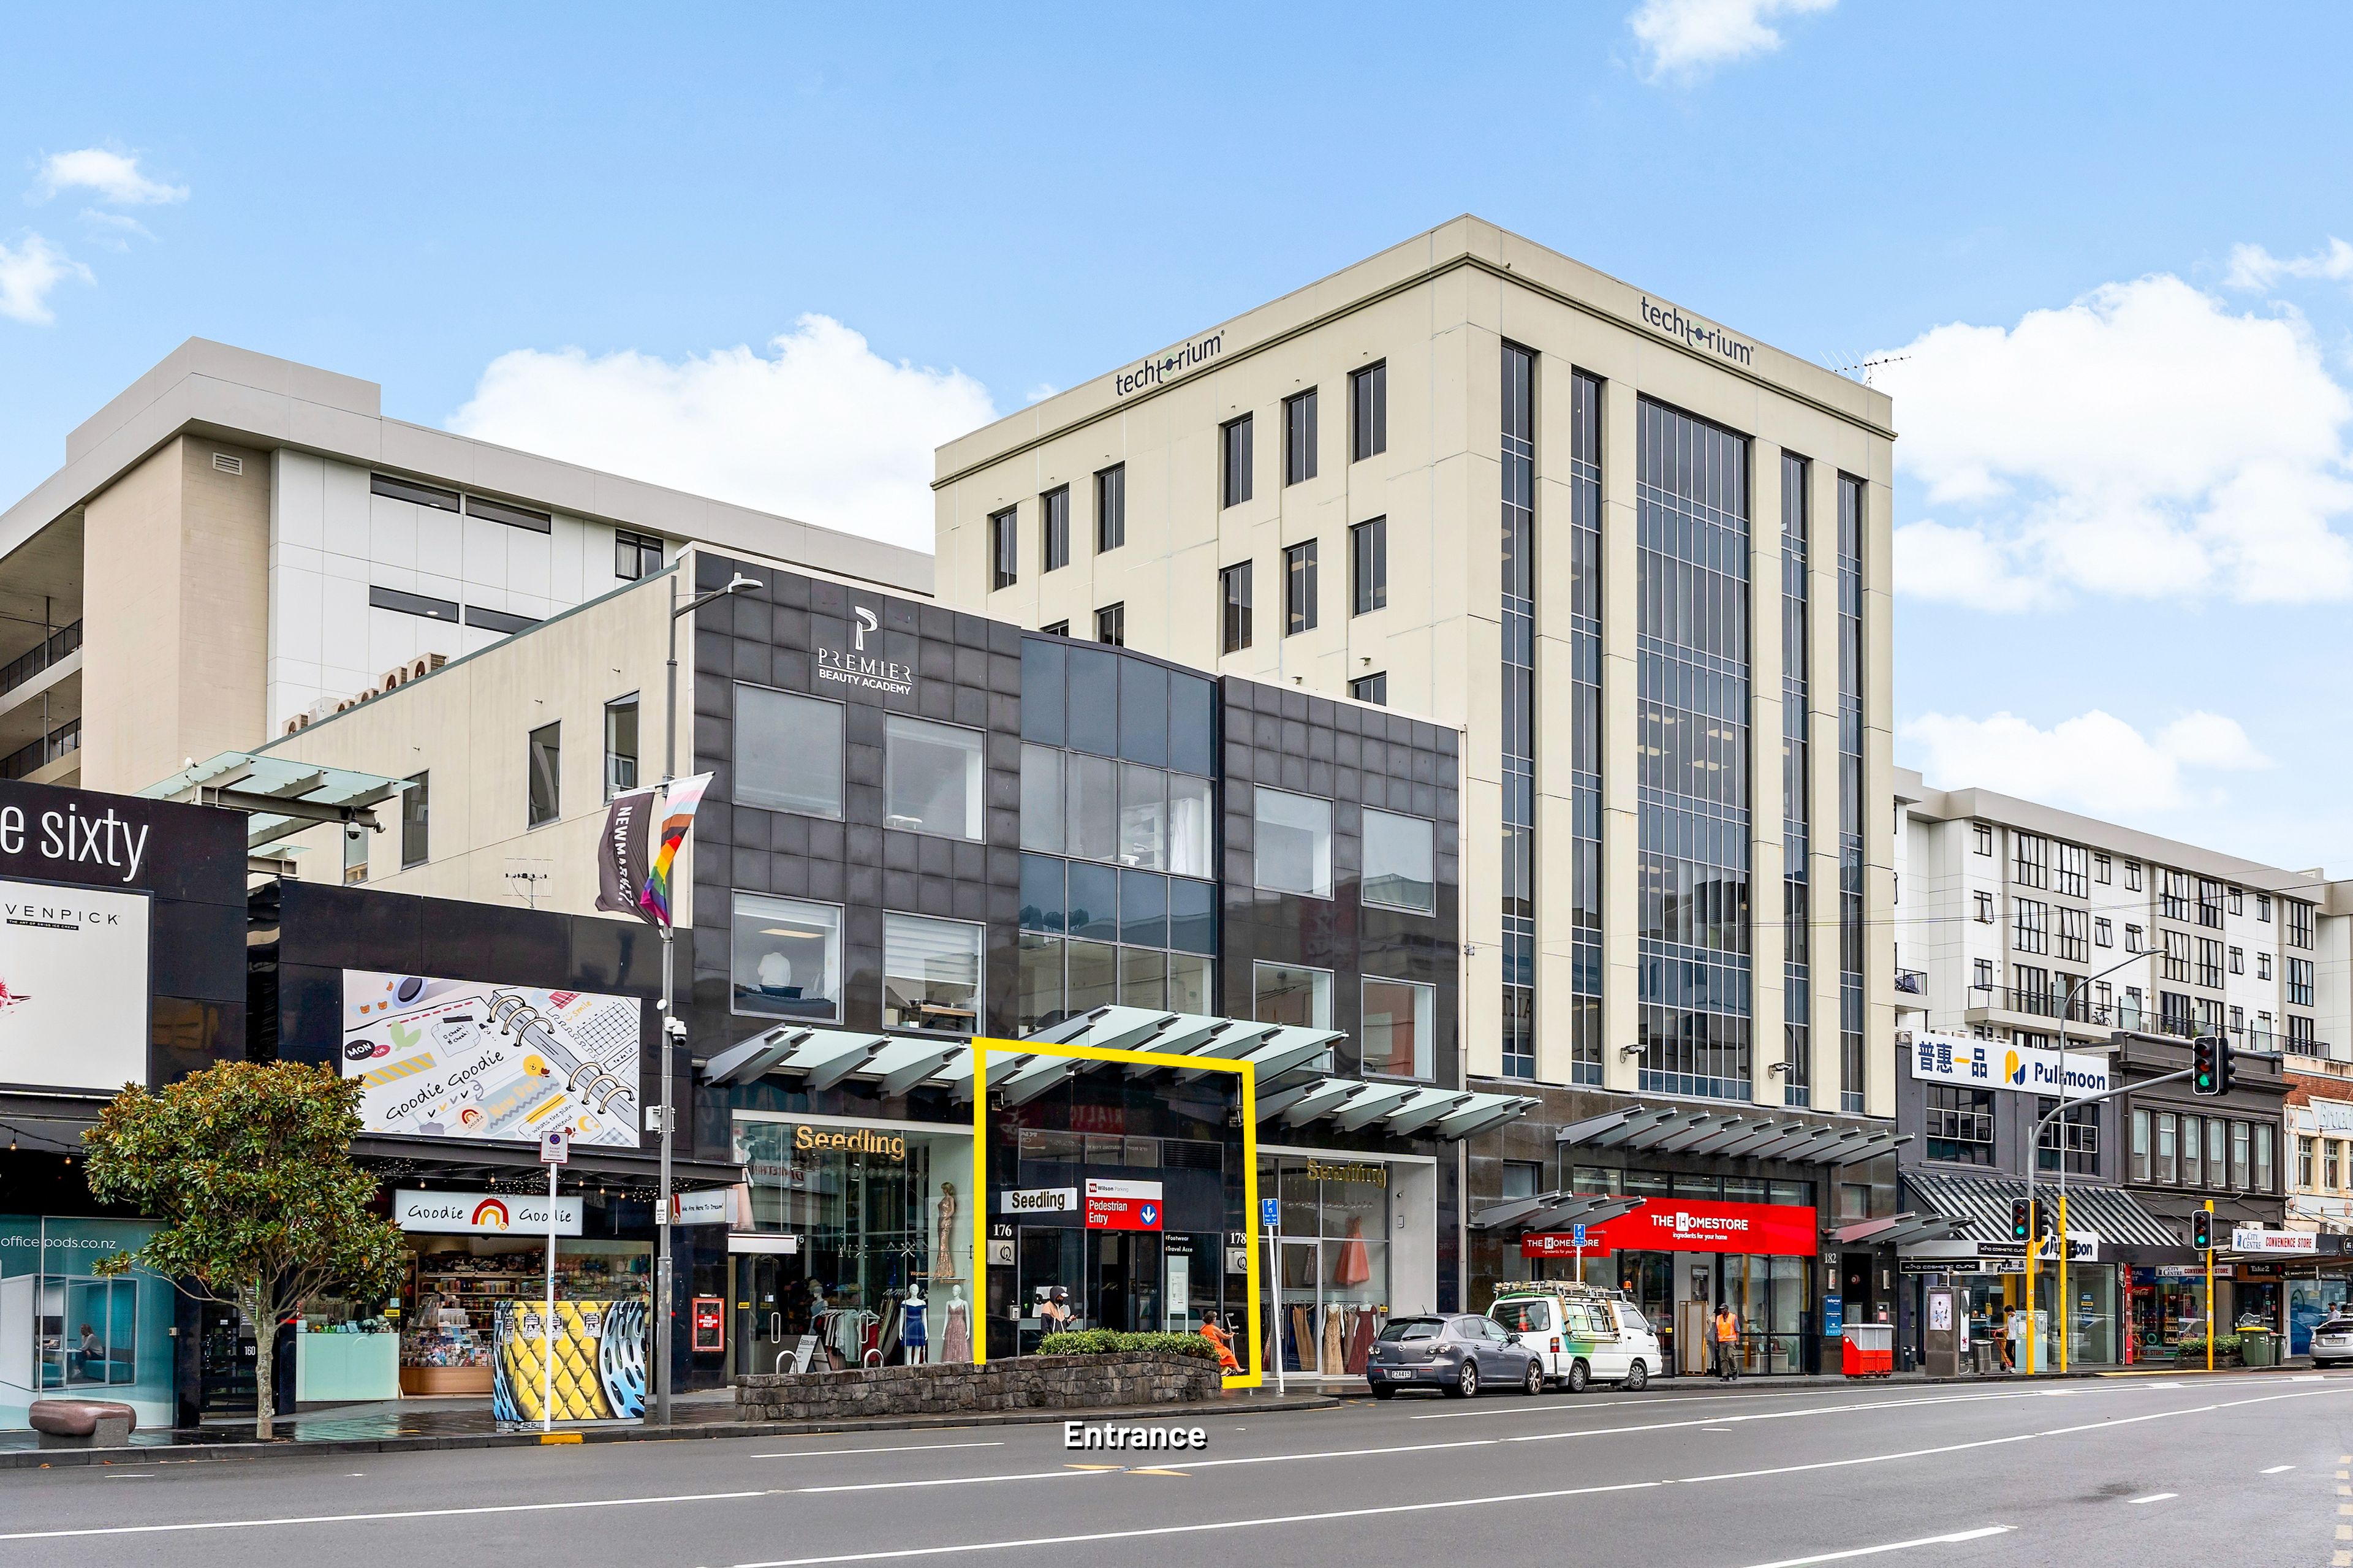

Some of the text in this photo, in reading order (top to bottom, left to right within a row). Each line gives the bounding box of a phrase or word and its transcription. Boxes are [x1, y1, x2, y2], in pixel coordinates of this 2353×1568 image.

[1641, 296, 1750, 366] techtorium
[1116, 335, 1220, 396] techtorium
[818, 647, 912, 683] PREMIER
[819, 668, 911, 695] BEAUTY ACADEMY
[40, 803, 150, 882] sixty
[5, 903, 118, 925] VENPICK
[347, 1042, 372, 1058] MON
[373, 1047, 386, 1056] TUE
[1918, 1040, 1988, 1078] 普惠一品
[386, 1050, 504, 1121] Goodie Goodie
[2034, 1062, 2105, 1090] Pulmoon
[488, 1096, 517, 1118] New
[796, 1125, 906, 1162] Seedling
[1306, 1159, 1387, 1189] Seedling
[1012, 1191, 1065, 1211] Seedling
[1089, 1199, 1127, 1211] Pedestrian
[408, 1205, 464, 1219] Goodie
[1089, 1212, 1108, 1225] Entry
[1651, 1211, 1749, 1231] THE HOMESTORE
[993, 1224, 1012, 1237] 176
[1230, 1232, 1247, 1244] 178
[1672, 1232, 1697, 1240] ingredients
[2265, 1237, 2312, 1249] CONVENIENCE STORE
[1824, 1252, 1837, 1263] 182
[244, 1346, 256, 1355] 160
